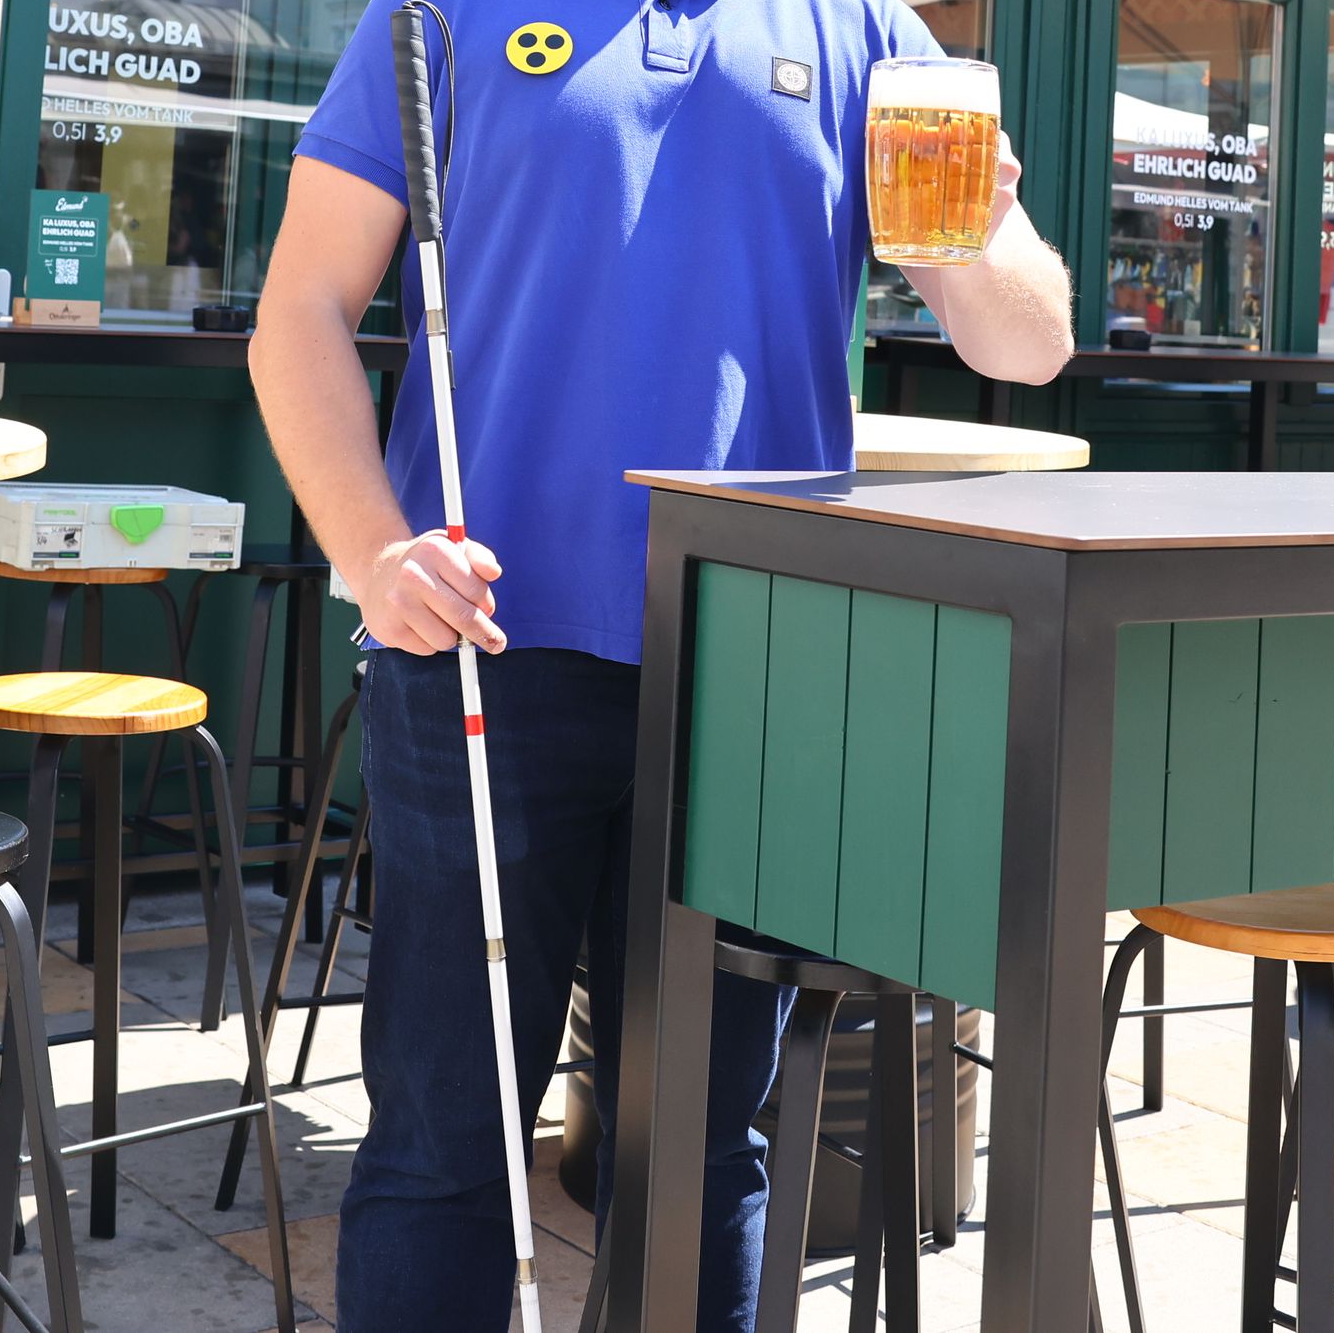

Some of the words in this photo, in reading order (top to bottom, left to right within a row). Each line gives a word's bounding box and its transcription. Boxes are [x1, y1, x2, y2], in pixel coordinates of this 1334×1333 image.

[140, 18, 203, 48] OBA
[115, 53, 202, 84] GUAD
[54, 98, 111, 116] HELLES
[114, 103, 149, 120] VOM
[152, 107, 194, 123] TANK
[94, 124, 122, 146] 3,9
[1222, 134, 1258, 157] OBA
[1133, 153, 1205, 179] EHRLICH
[1208, 161, 1257, 184] GUAD
[1134, 192, 1174, 207] EDMUND
[1175, 195, 1208, 209] HELLES
[1208, 199, 1229, 211] VOM
[1229, 201, 1254, 214] TANK
[1197, 214, 1214, 231] 3,9
